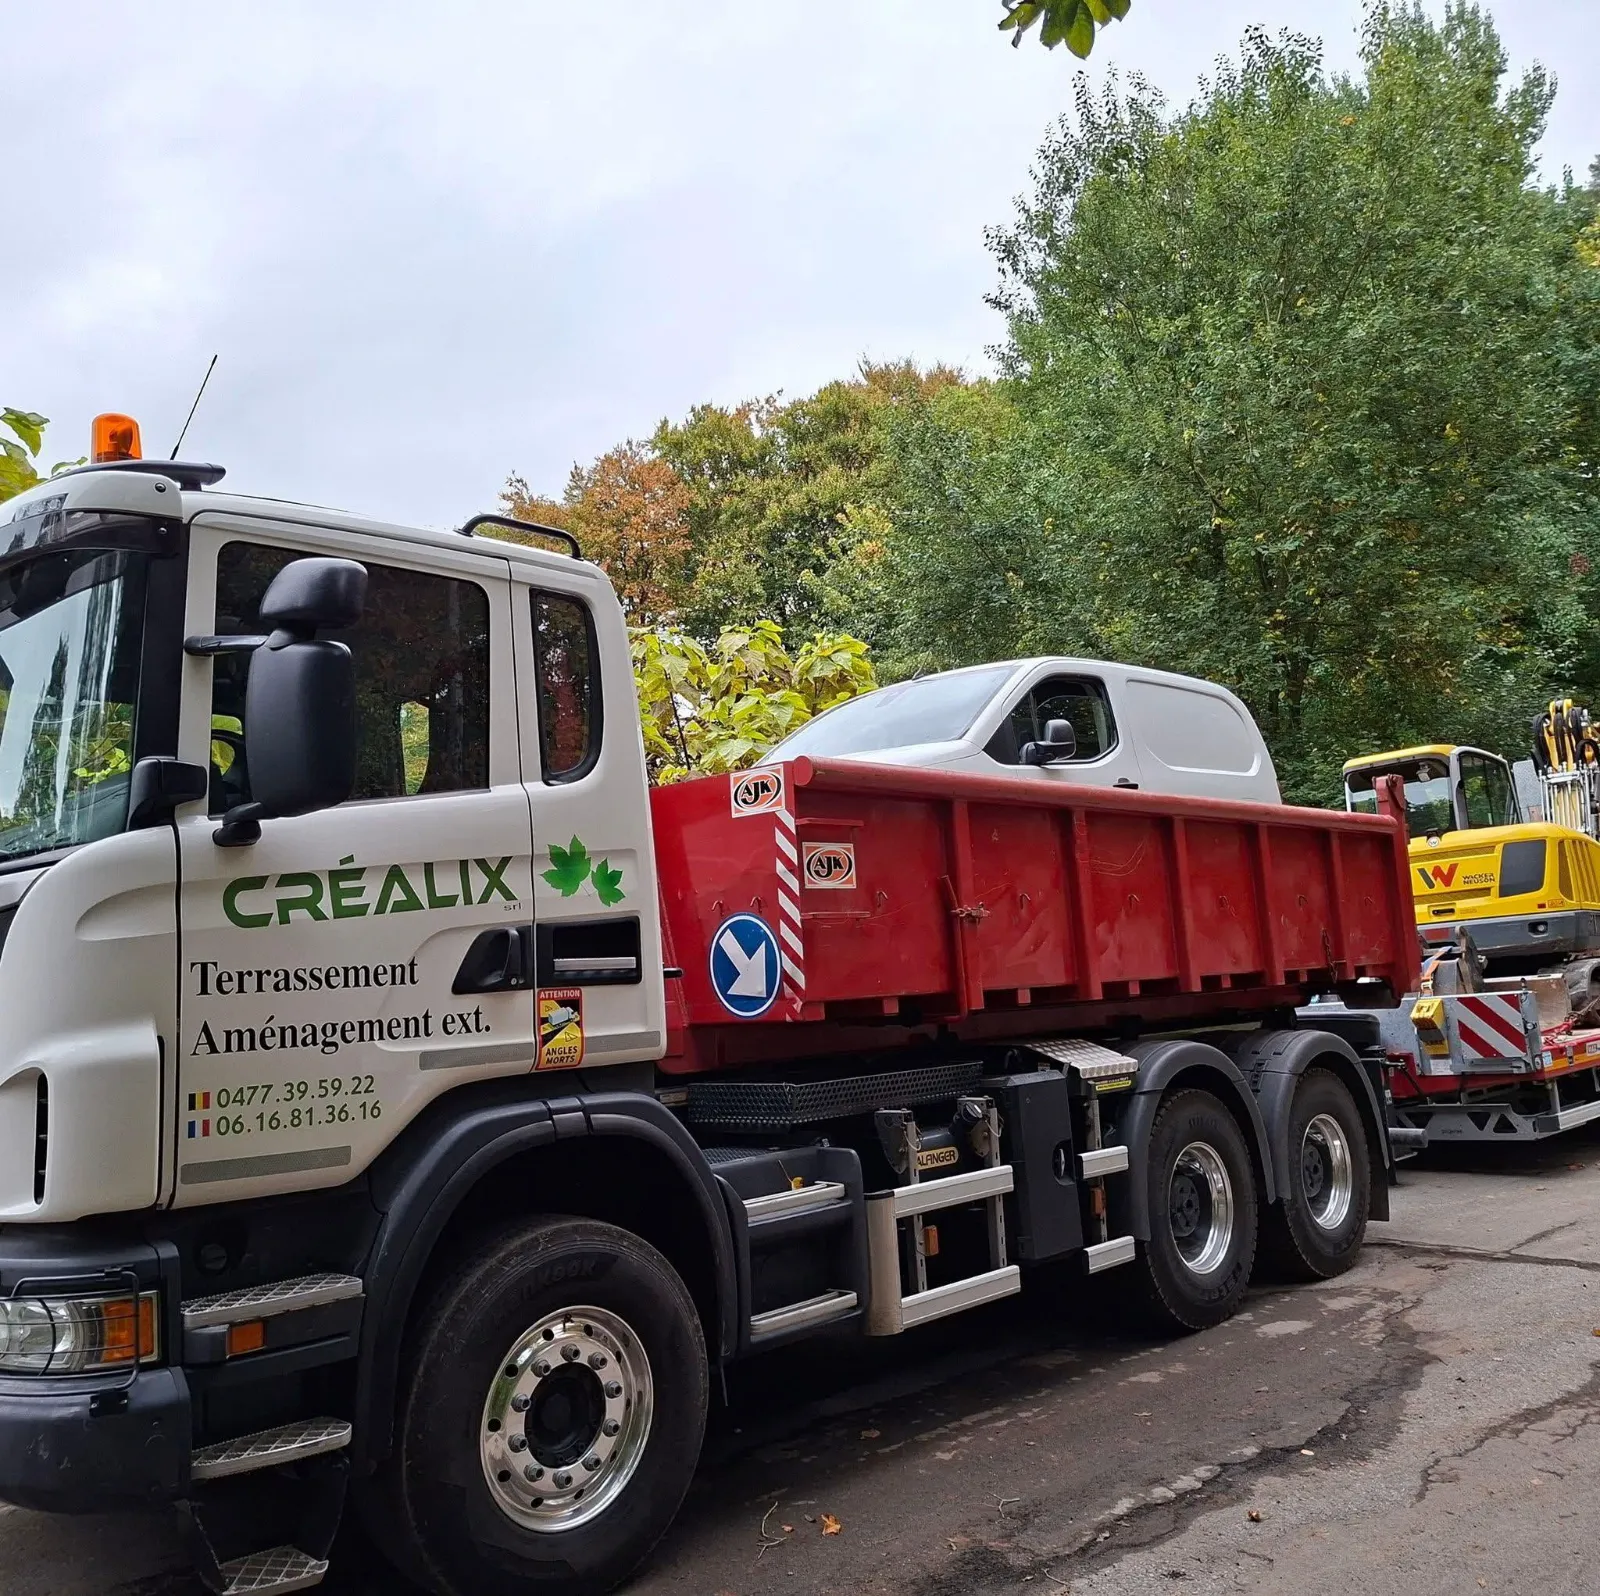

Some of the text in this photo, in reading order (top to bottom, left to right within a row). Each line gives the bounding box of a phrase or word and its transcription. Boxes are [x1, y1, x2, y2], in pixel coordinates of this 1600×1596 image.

[740, 780, 772, 804] AJK
[813, 856, 844, 879] AJK
[222, 854, 519, 929] CRÉALIX
[1463, 878, 1496, 886] NEUSON
[190, 956, 420, 996] Terrassement
[540, 990, 580, 998] ATTENTION
[190, 1005, 492, 1056] Aménagement ext.
[545, 1046, 578, 1056] ANGLES
[545, 1055, 576, 1065] MORTS
[217, 1075, 376, 1109] 0477.39.59.22
[216, 1101, 382, 1137] 06.16.81.36.16
[917, 1150, 956, 1166] ALFINGER
